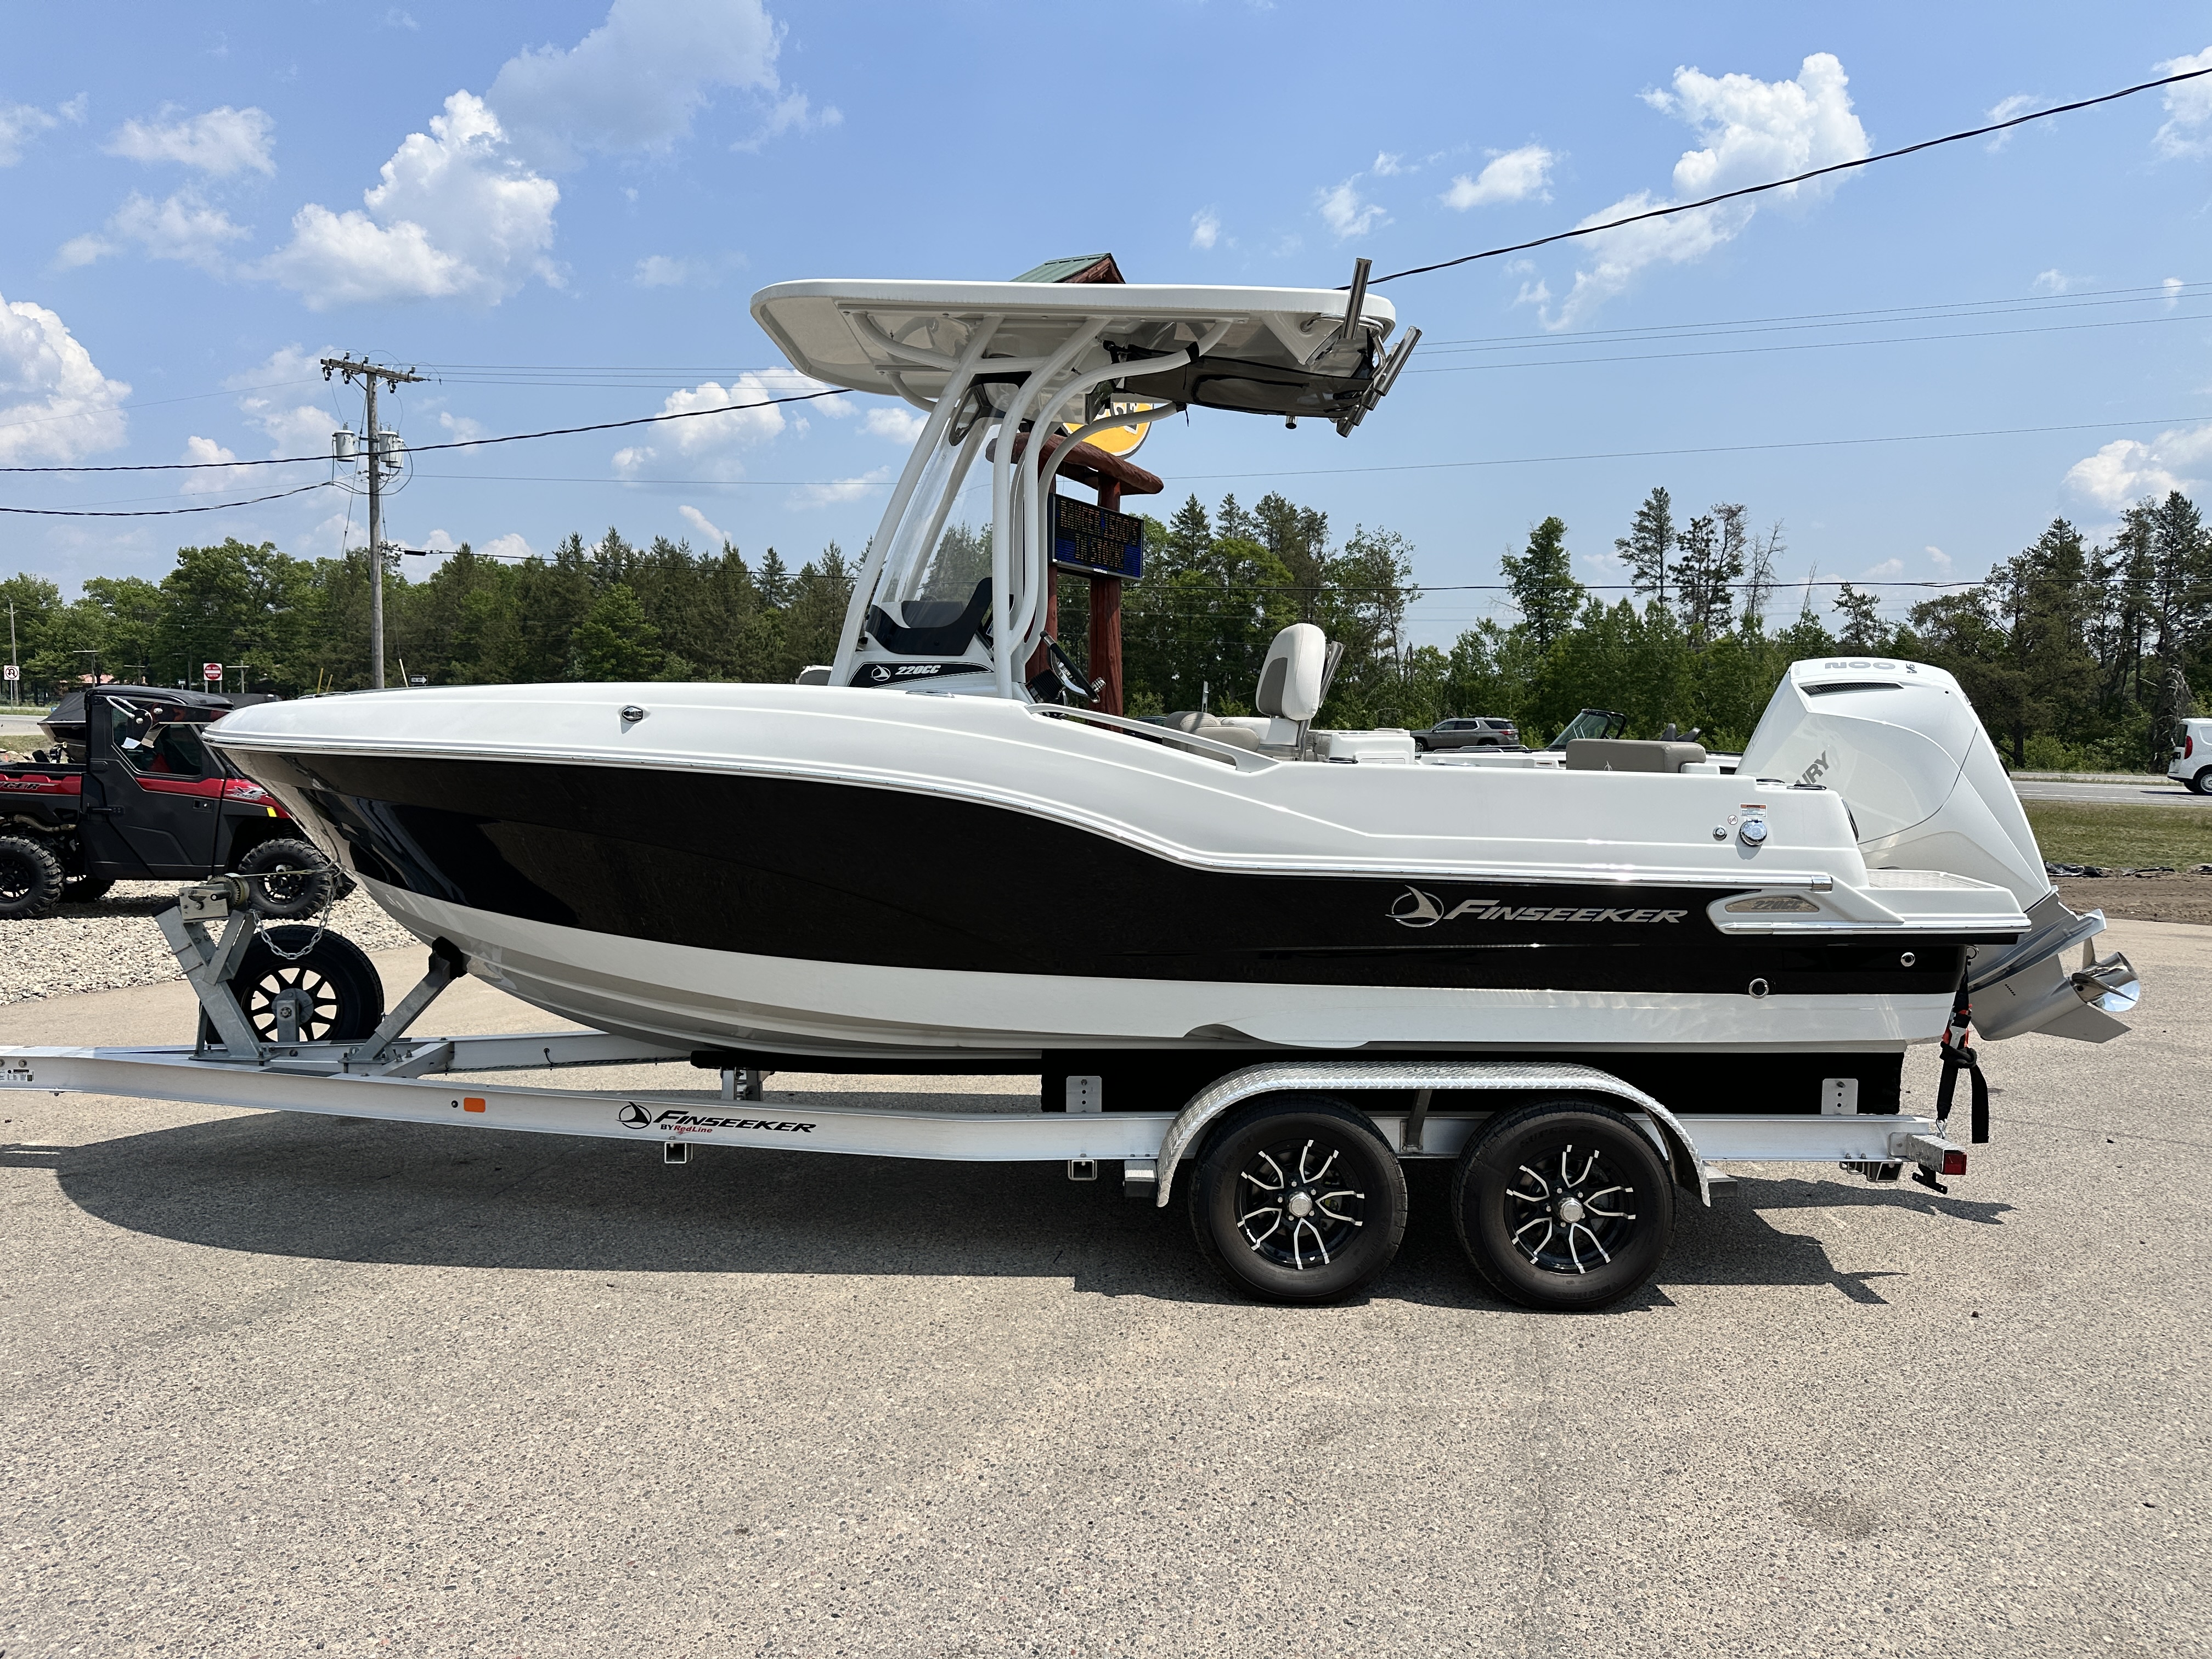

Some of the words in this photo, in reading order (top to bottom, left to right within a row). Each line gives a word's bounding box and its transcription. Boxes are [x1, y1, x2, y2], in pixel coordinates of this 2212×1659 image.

[895, 665, 941, 675] 220CC
[1825, 661, 1895, 670] 200
[1751, 900, 1803, 910] 220CC
[1443, 900, 1688, 923] FINSEEKER
[653, 1110, 817, 1133] FINSEEKER
